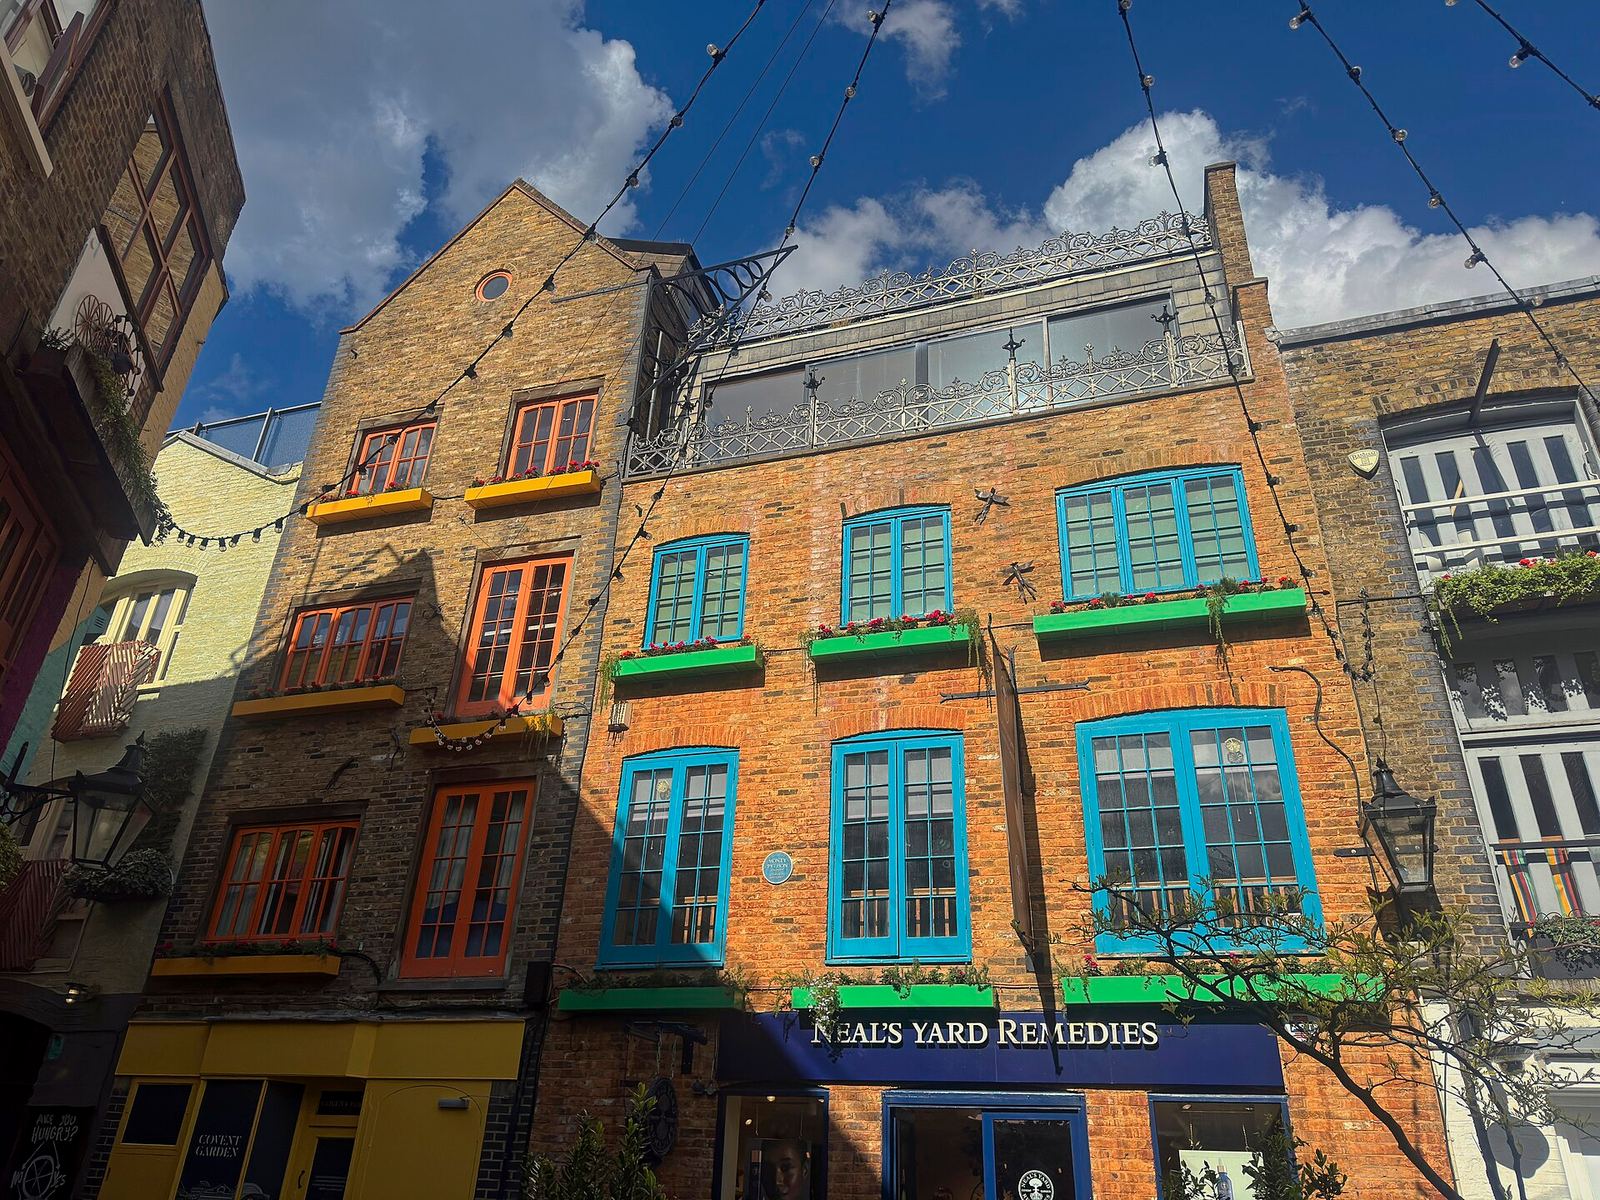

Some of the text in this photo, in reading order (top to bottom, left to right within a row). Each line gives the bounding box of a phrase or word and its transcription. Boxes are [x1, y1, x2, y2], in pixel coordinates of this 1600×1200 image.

[912, 1022, 988, 1044] YARD
[36, 1112, 77, 1126] ARE YOU
[31, 1125, 79, 1144] HUNGRY?
[198, 1134, 242, 1146] COVENT
[195, 1145, 239, 1157] GARDEN
[1038, 1174, 1051, 1189] YARD
